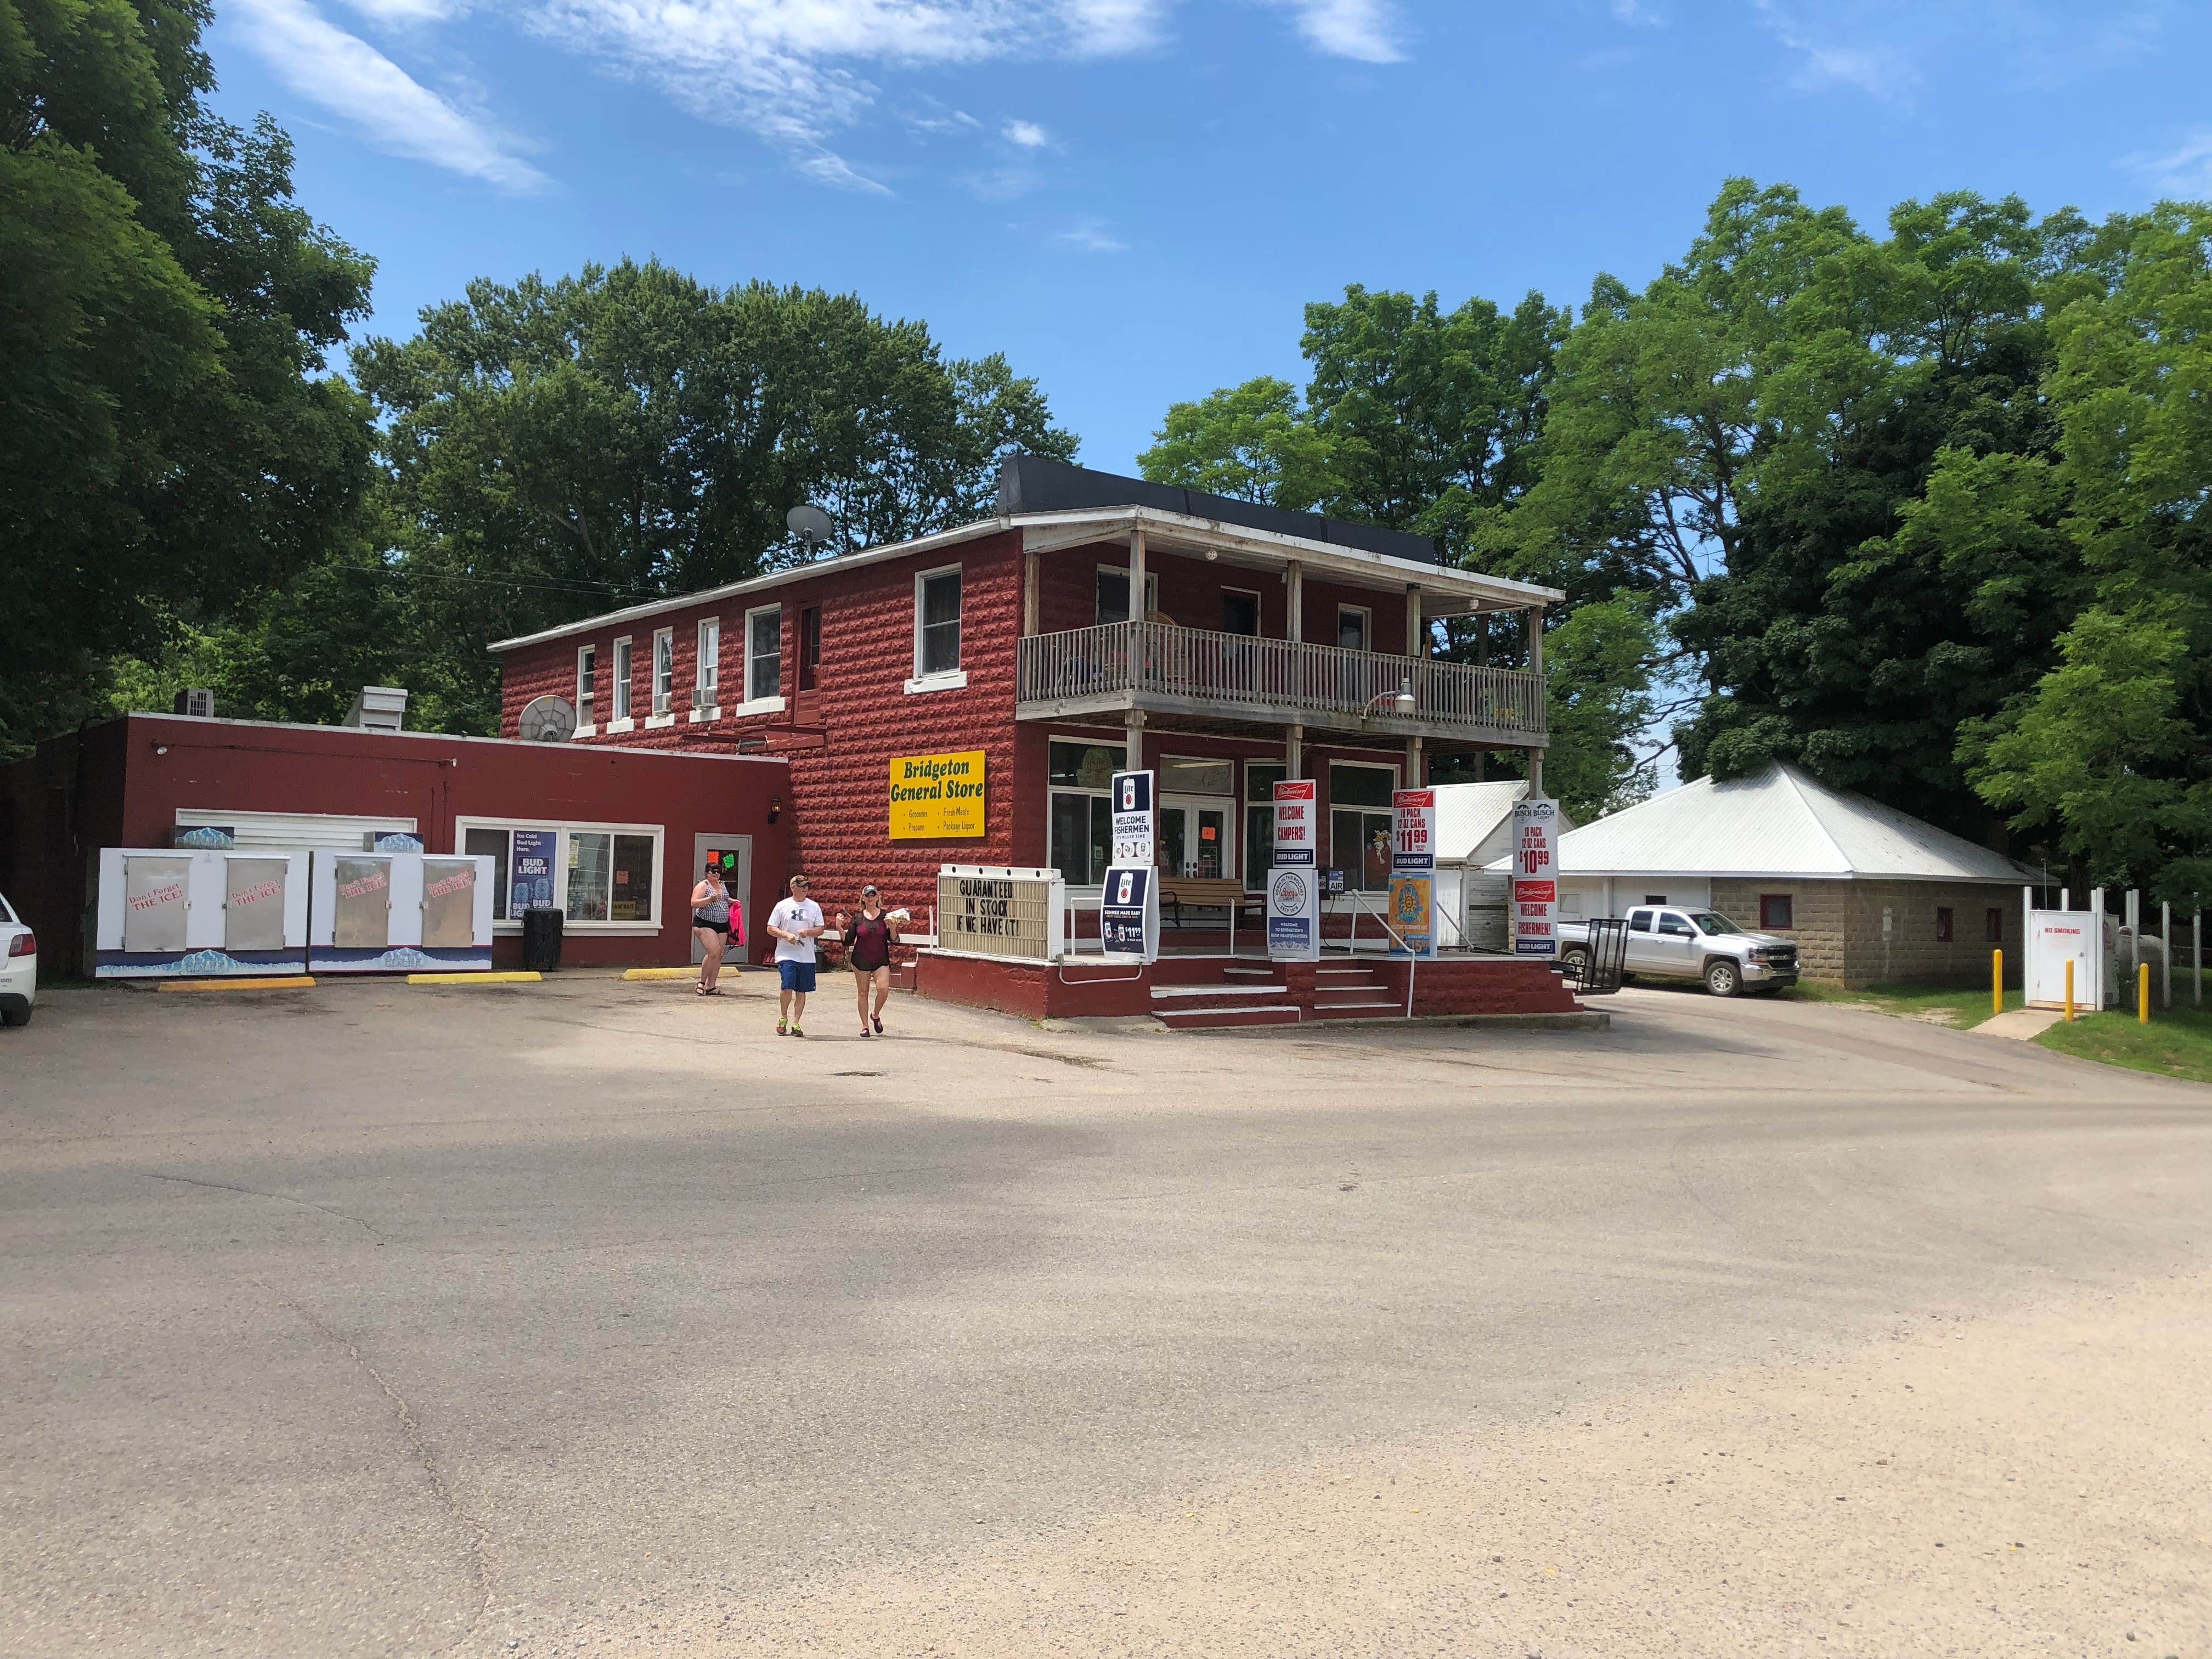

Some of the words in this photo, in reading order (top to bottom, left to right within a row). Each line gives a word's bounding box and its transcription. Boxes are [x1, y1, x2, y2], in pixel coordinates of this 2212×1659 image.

[904, 759, 969, 781] Bridgeton
[891, 781, 942, 802] General
[946, 780, 983, 798] Store
[1125, 785, 1133, 794] Lite
[909, 809, 928, 817] Groceries
[944, 808, 955, 816] Fresh
[956, 806, 969, 816] Meats
[1279, 806, 1304, 820] WELCOME
[1407, 808, 1421, 817] PACK
[1116, 816, 1146, 825] WELCOME
[1398, 819, 1402, 828] 12
[1403, 819, 1408, 828] OZ
[1410, 819, 1425, 828] CANS
[909, 822, 924, 833] Propane
[944, 821, 961, 832] Package
[962, 821, 975, 832] Liquor
[1114, 825, 1149, 834] FISHERMEN
[1531, 827, 1542, 837] PACK
[1278, 826, 1305, 840] CAMPERS!
[1522, 839, 1526, 848] 12
[1534, 838, 1546, 848] CANS
[523, 858, 544, 866] BUD
[518, 866, 547, 874] LIGHT
[1121, 879, 1131, 887] Lite
[153, 883, 179, 895] Forget
[960, 880, 1013, 898] GUARANTEED
[1281, 888, 1298, 896] Coors
[132, 899, 157, 911] THE
[160, 890, 183, 902] ICE!
[235, 894, 257, 906] THE
[966, 898, 974, 915] IN
[980, 899, 1008, 917] STOCK
[1521, 904, 1547, 916] WELCOME
[957, 915, 962, 931] IF
[966, 916, 977, 933] WE
[981, 917, 1002, 935] HAVE
[1519, 922, 1550, 935] FISHERMEN!
